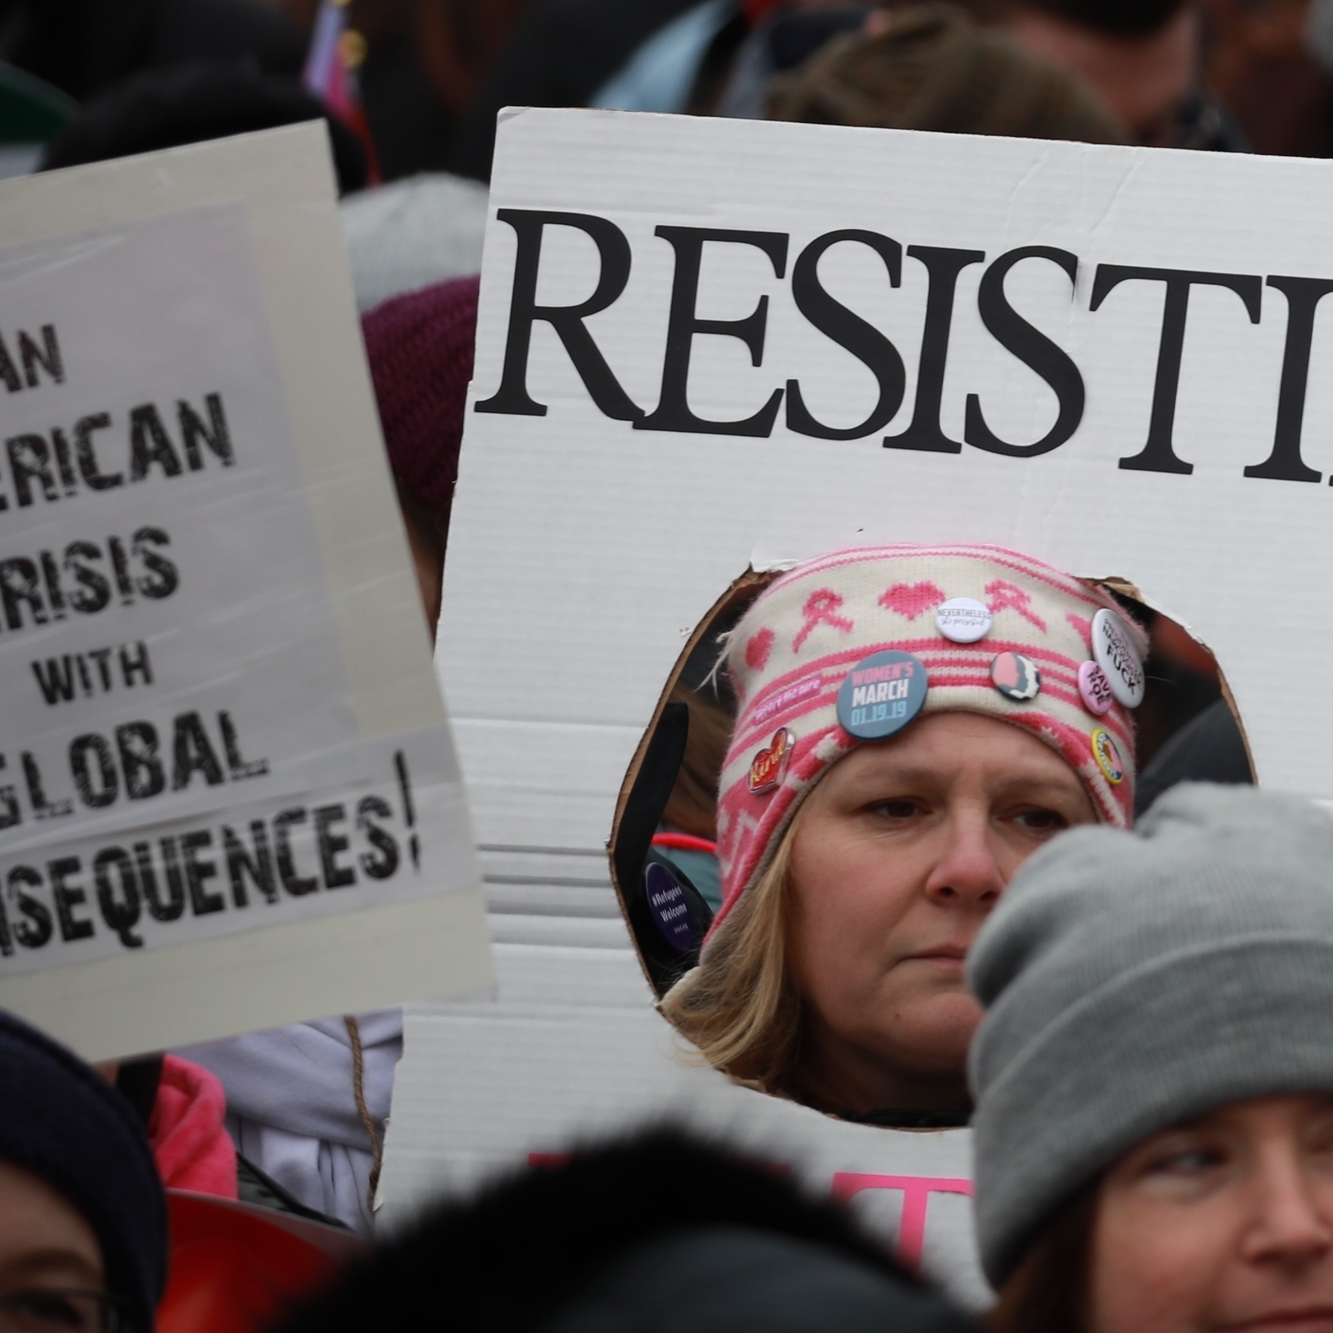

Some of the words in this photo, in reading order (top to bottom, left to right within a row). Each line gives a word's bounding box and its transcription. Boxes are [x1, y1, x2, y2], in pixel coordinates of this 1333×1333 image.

[0, 392, 236, 512] RICAN
[0, 525, 180, 631] RISIS
[31, 640, 154, 706] WITH
[851, 661, 914, 687] WOMEN'S
[851, 678, 910, 707] MARCH
[850, 700, 907, 727] 01.19.19
[0, 748, 421, 957] SEQUENCES!
[651, 885, 683, 908] #Refugees
[659, 902, 688, 923] Welcome
